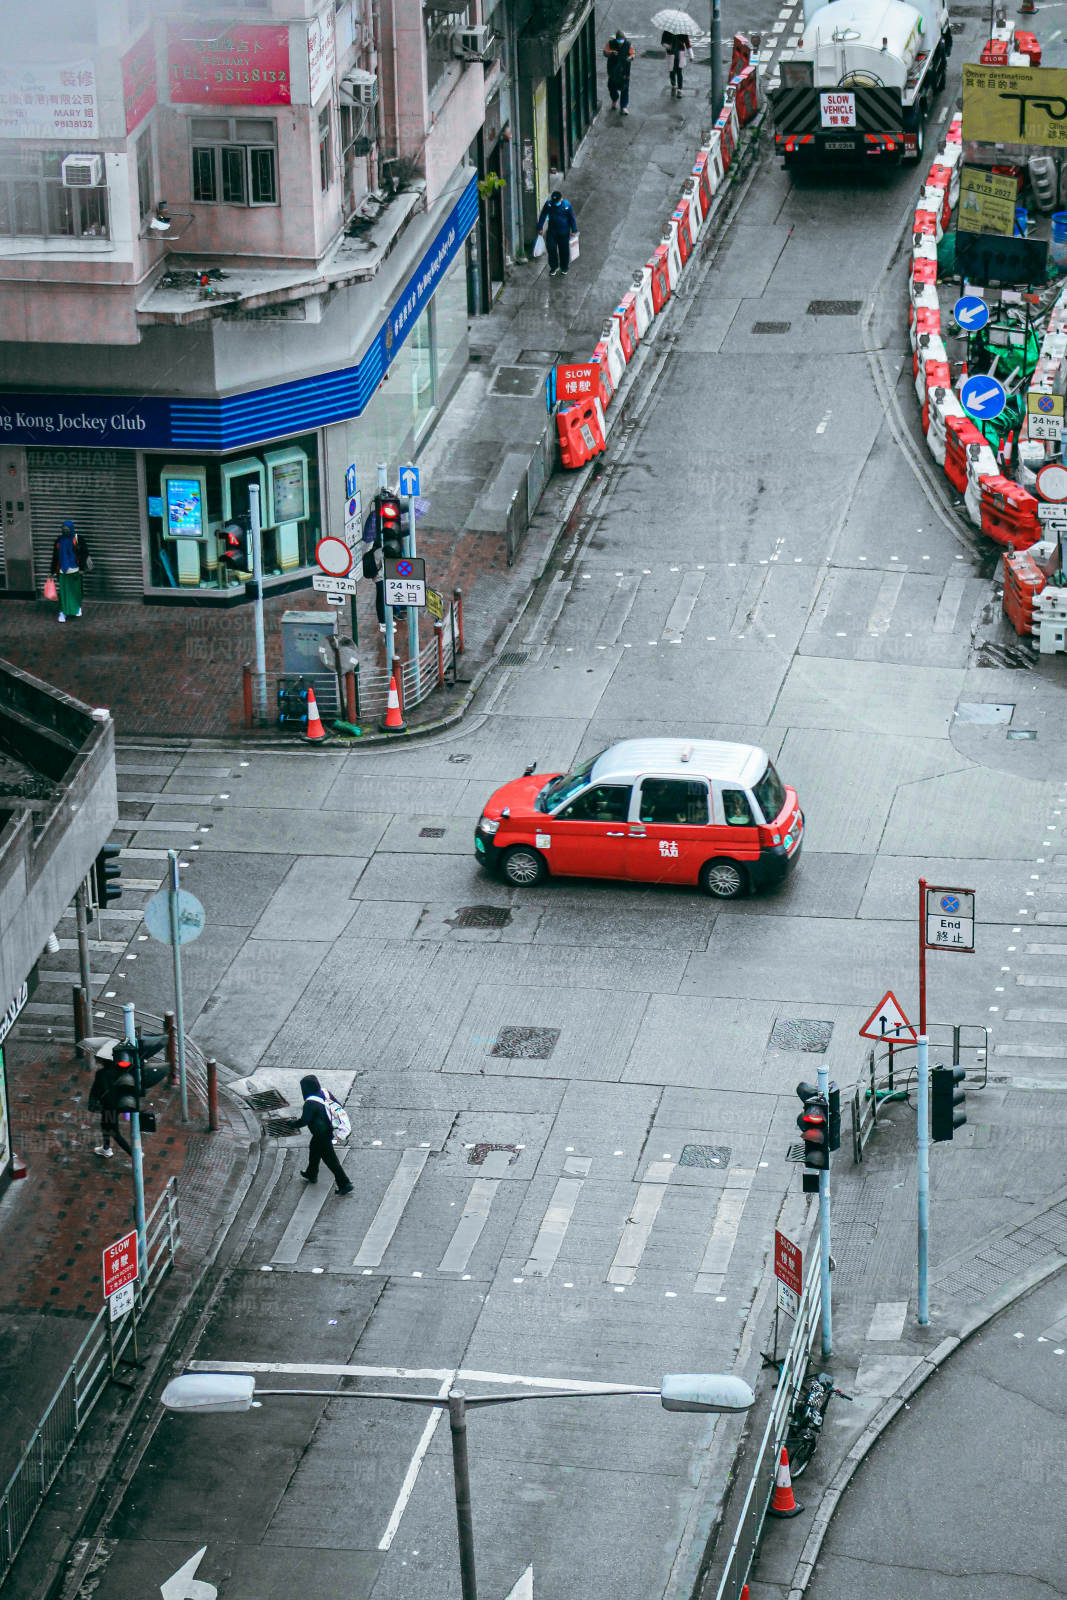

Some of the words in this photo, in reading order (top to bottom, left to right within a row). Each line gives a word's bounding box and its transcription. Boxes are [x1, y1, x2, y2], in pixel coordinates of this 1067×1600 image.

[214, 68, 286, 83] 98138132
[827, 95, 849, 105] SLOW
[823, 105, 854, 115] VEHICLE
[565, 369, 591, 379] SLOW
[16, 412, 54, 432] Kong
[57, 413, 107, 433] Jockey
[111, 414, 146, 430] Club
[1033, 416, 1044, 425] 24
[1046, 417, 1060, 426] hrs
[1036, 427, 1057, 437] 全日
[336, 582, 346, 591] 12
[390, 582, 403, 590] 24
[406, 582, 421, 591] hrs
[393, 591, 417, 602] 全日
[659, 840, 678, 850] 的士
[660, 849, 679, 857] TAXI
[941, 919, 961, 929] End
[936, 931, 964, 943] 終止
[110, 1239, 130, 1258] SLOW
[780, 1236, 797, 1256] SLOW
